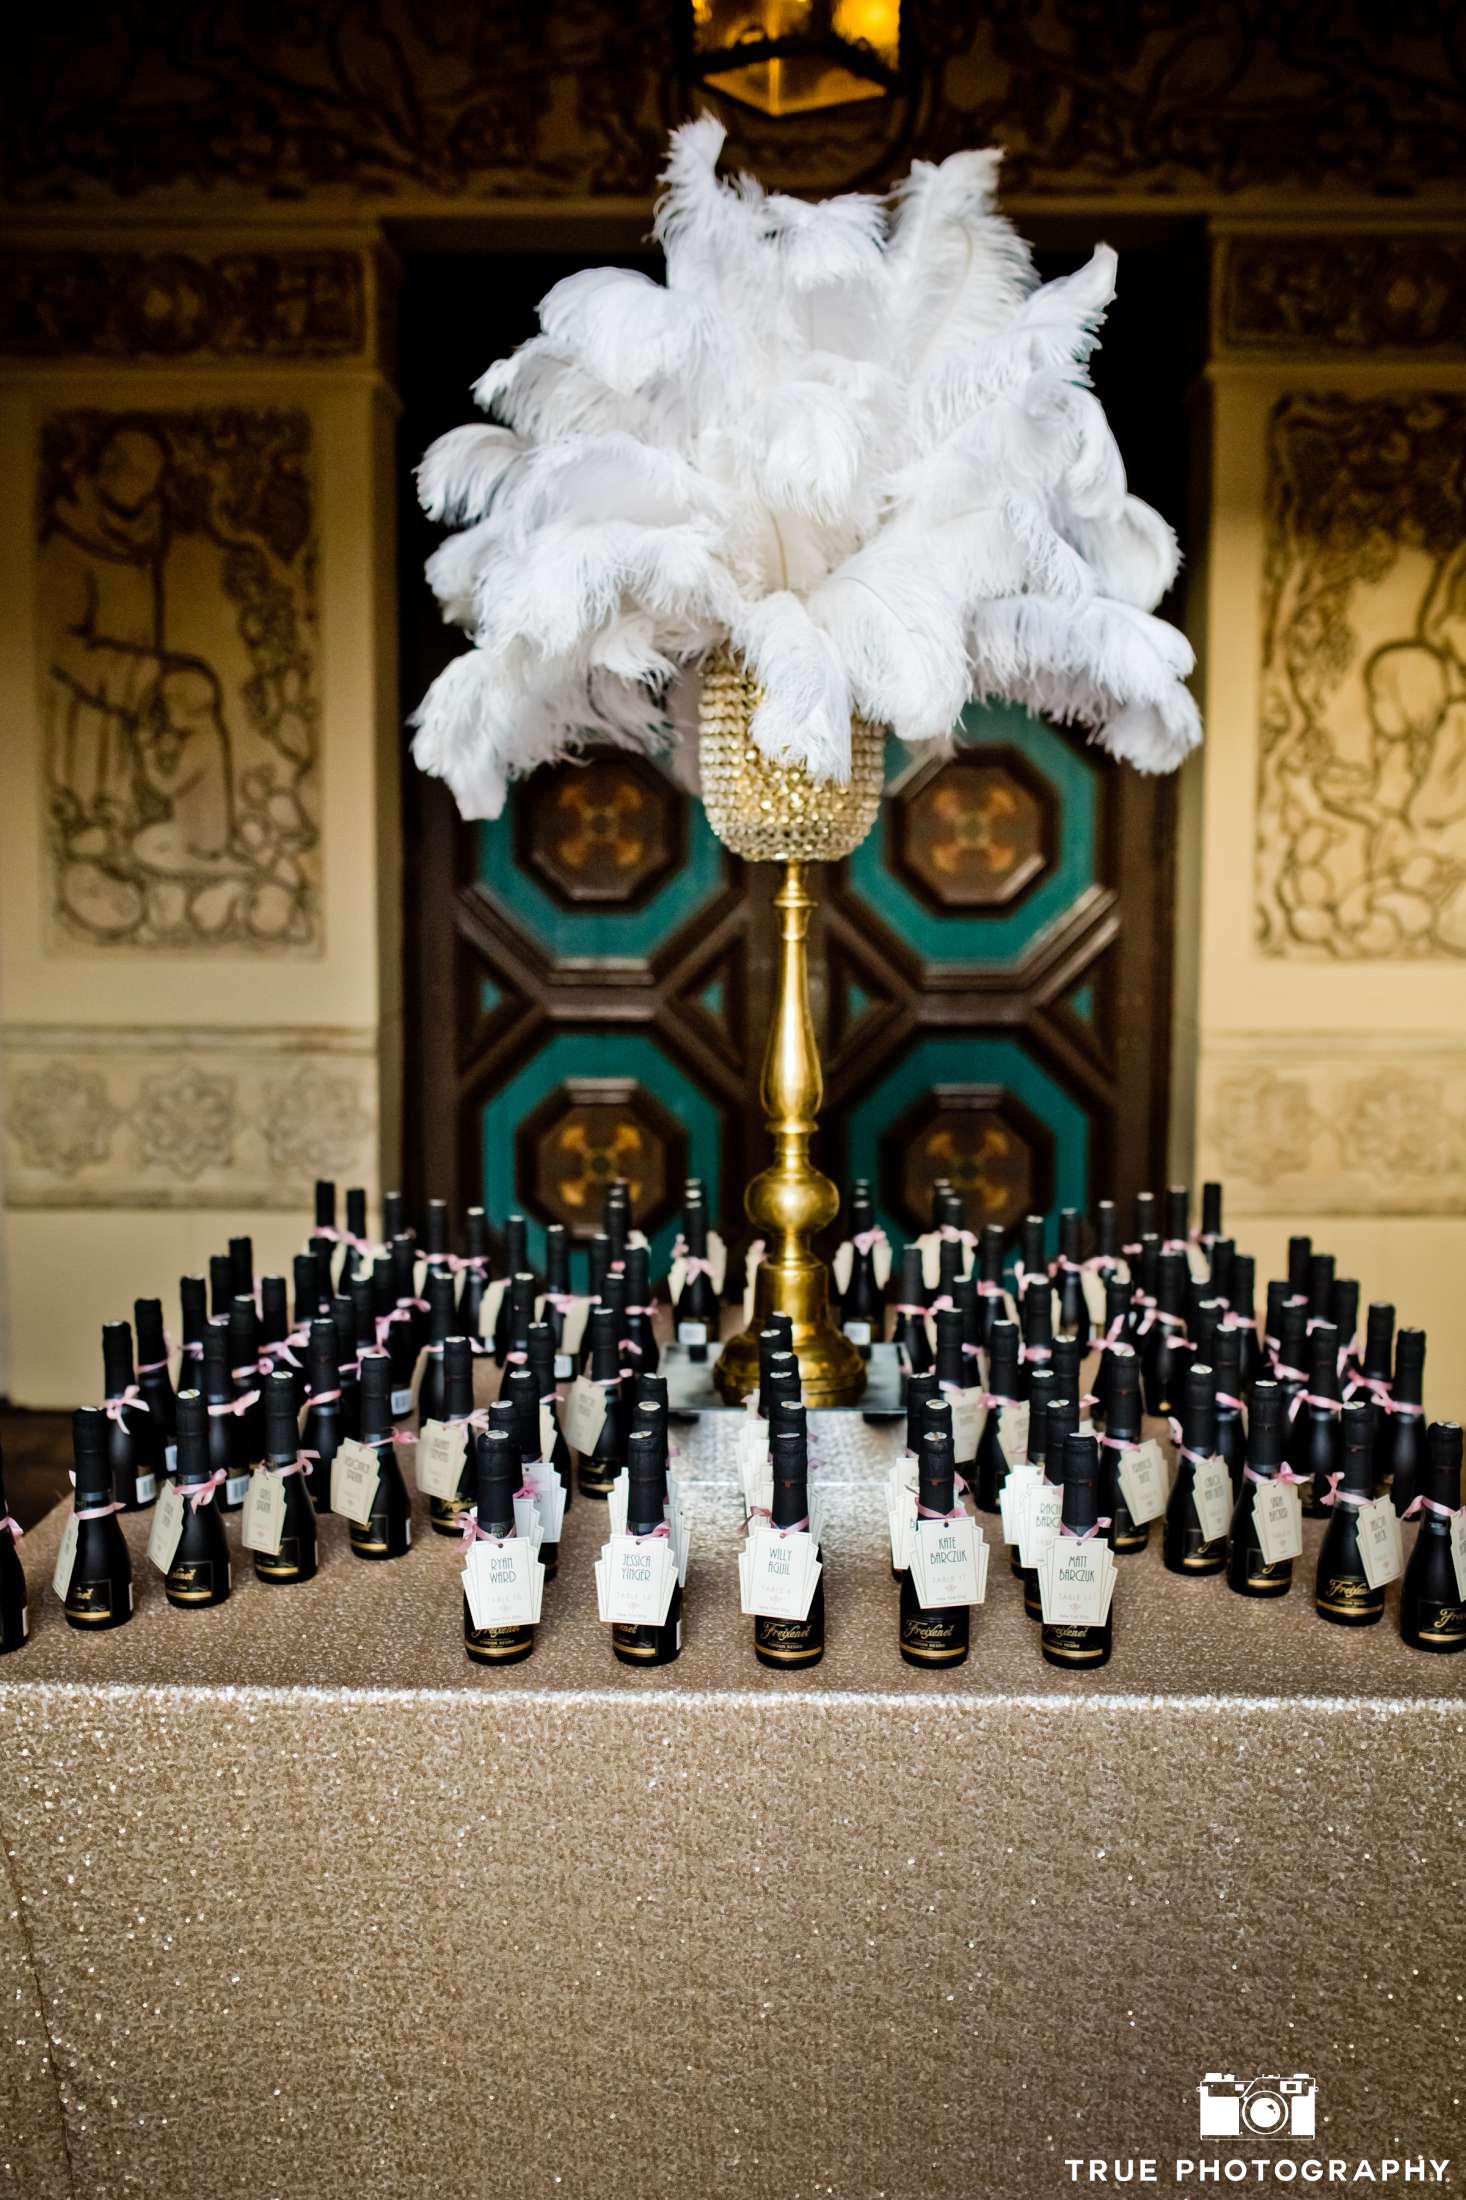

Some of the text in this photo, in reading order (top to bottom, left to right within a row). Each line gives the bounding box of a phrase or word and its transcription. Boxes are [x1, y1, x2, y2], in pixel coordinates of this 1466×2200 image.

[938, 1536, 958, 1550] KATE
[622, 1553, 652, 1568] JESSICA
[769, 1546, 793, 1562] WILLY
[1068, 1555, 1088, 1568] MATT
[490, 1556, 513, 1571] RYAN
[489, 1570, 518, 1585] WARD
[761, 1620, 812, 1641] Freixenet
[904, 1618, 955, 1639] Freixenet
